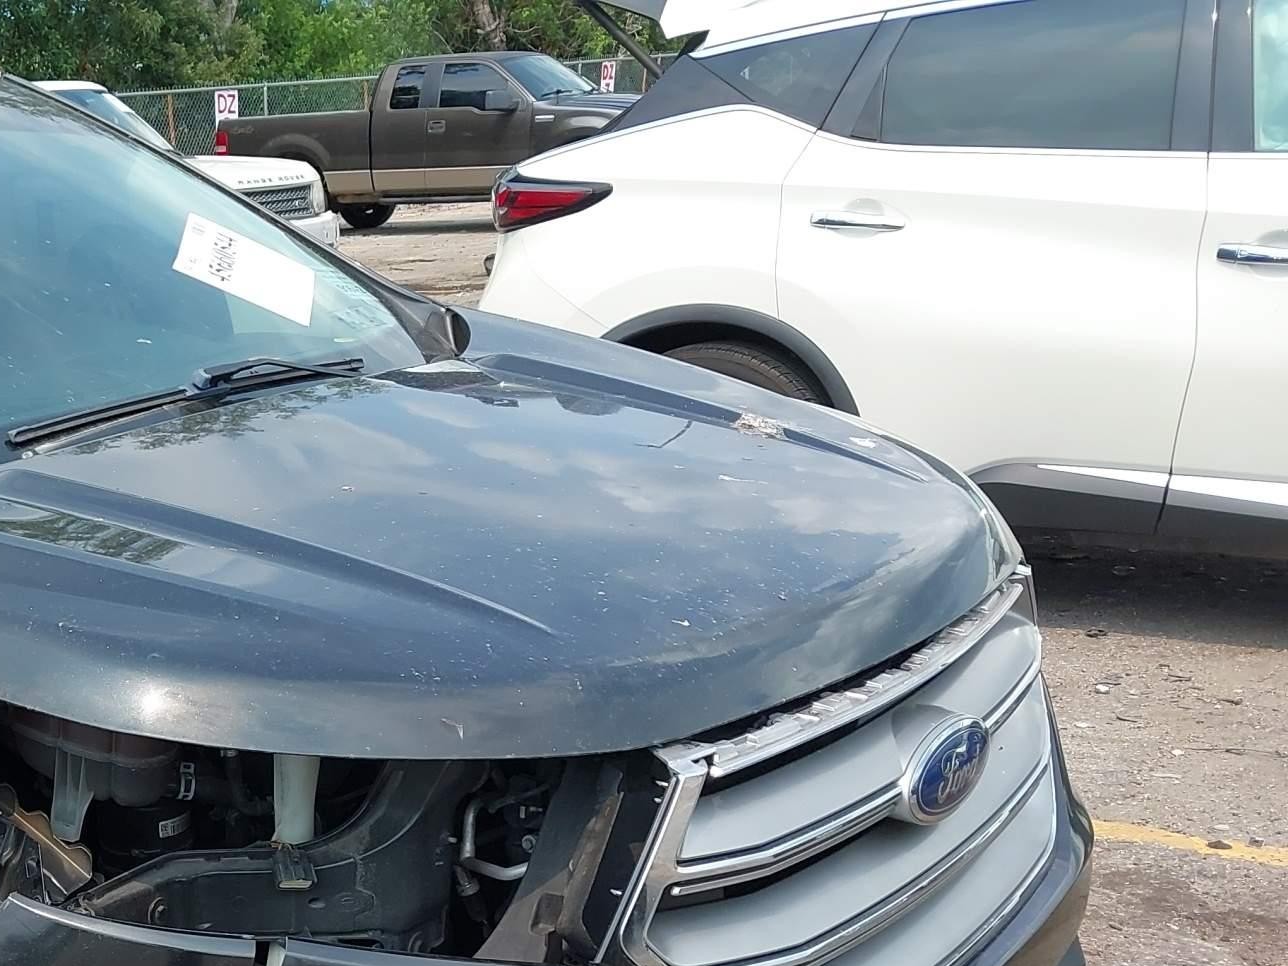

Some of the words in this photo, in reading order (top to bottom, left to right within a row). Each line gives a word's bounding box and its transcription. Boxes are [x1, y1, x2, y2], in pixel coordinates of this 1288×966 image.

[602, 63, 614, 81] DZ
[217, 93, 237, 114] DZ
[937, 740, 981, 804] Ford
